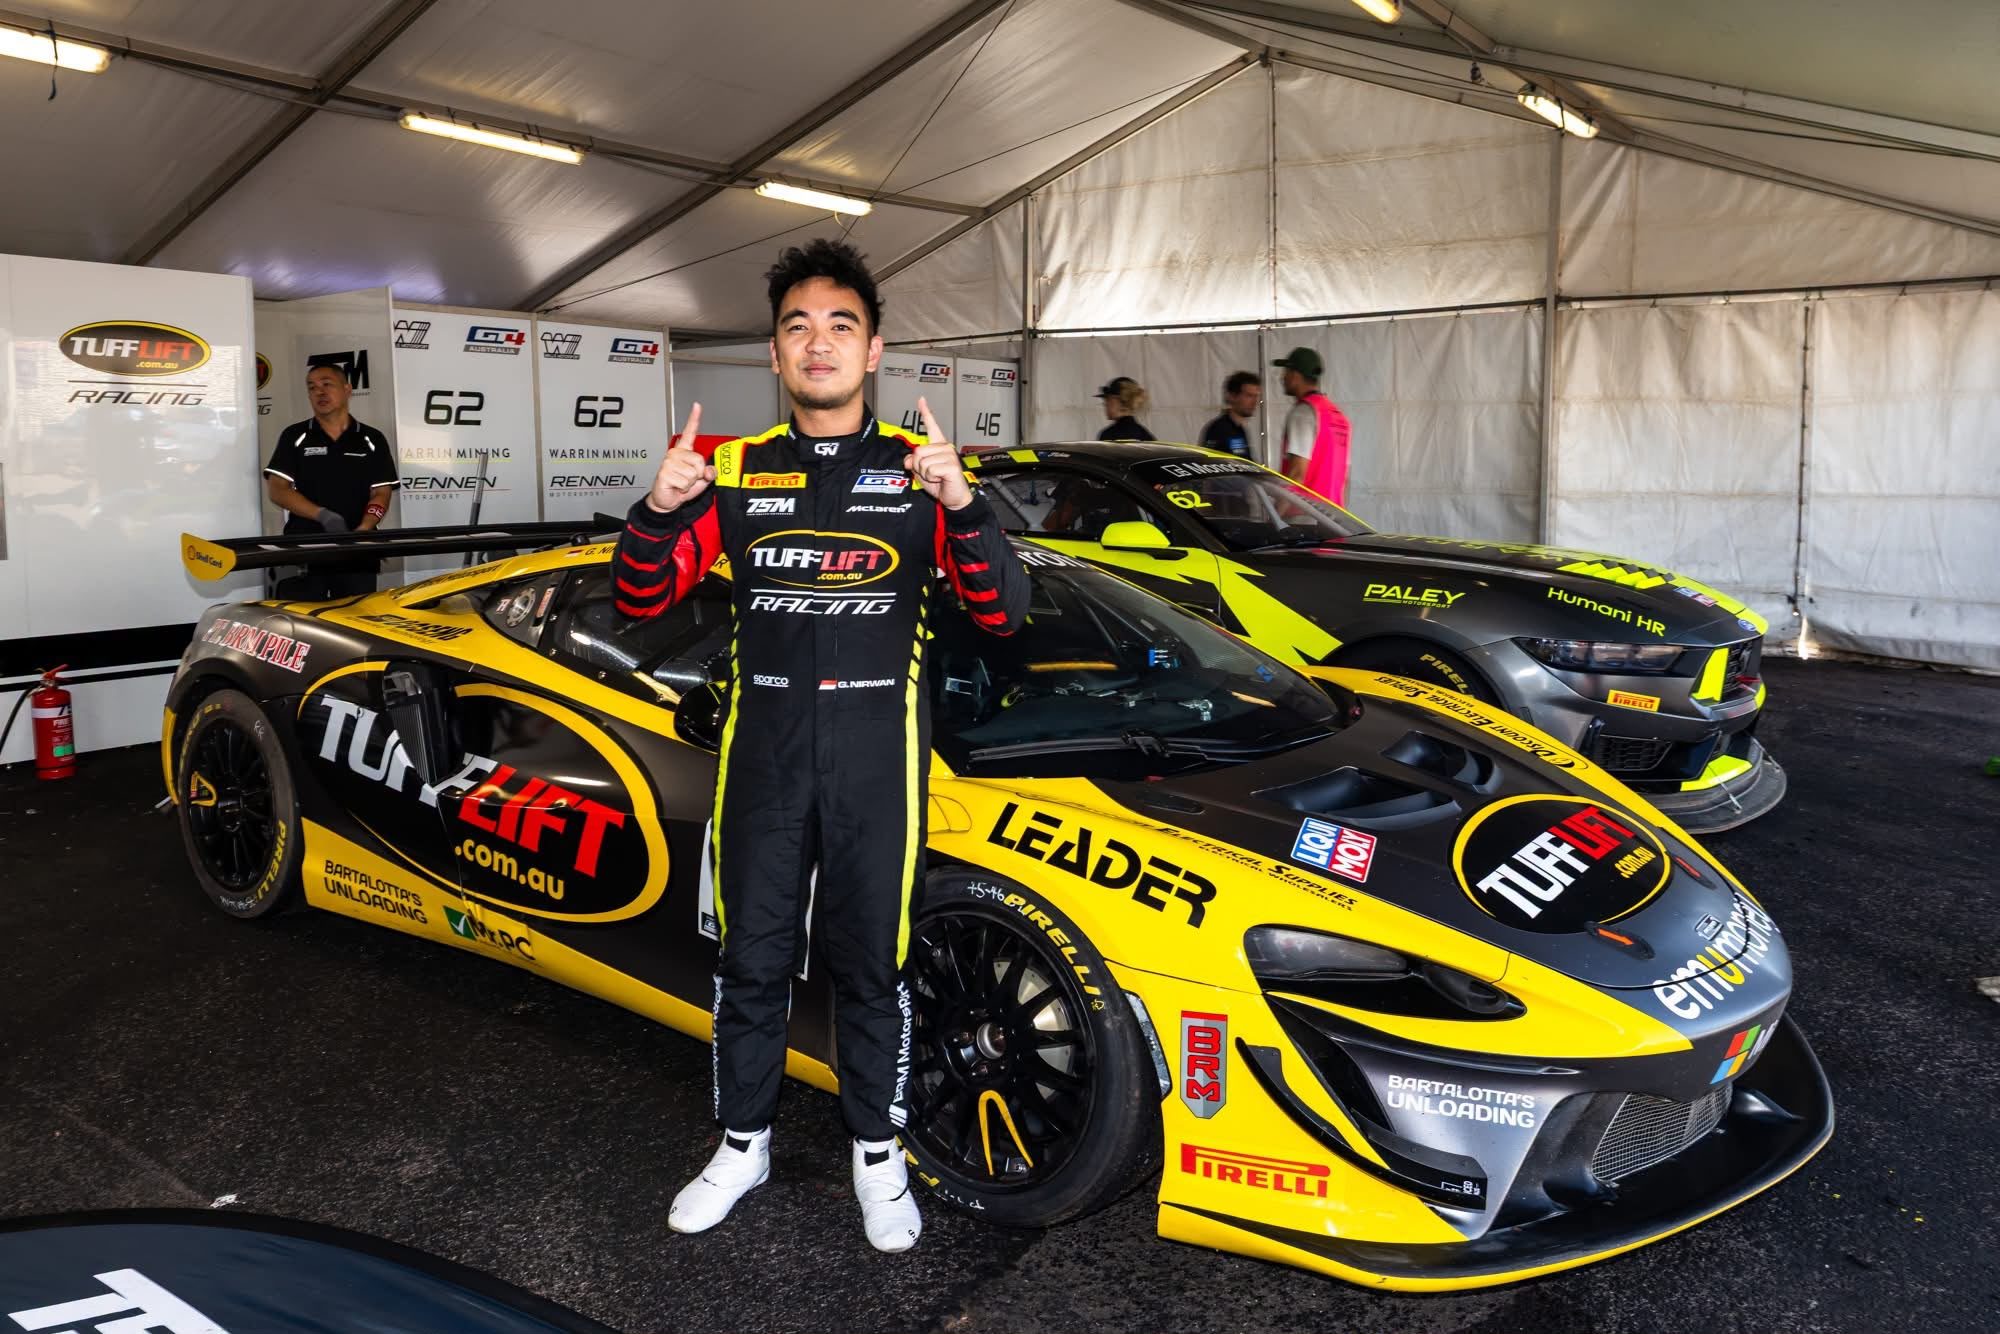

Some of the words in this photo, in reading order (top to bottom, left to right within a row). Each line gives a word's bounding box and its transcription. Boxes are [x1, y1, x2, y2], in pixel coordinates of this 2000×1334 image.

[69, 336, 197, 361] TUFFLIFT
[613, 355, 650, 364] AUSTRALIA
[136, 361, 179, 369] .com.au
[68, 390, 206, 406] RACING
[424, 390, 485, 425] 62
[574, 395, 624, 428] 62
[976, 412, 1001, 436] 46
[400, 448, 452, 459] ARRIN
[456, 448, 511, 459] MINING
[549, 448, 599, 459] WARRIN
[602, 449, 648, 459] MINING
[550, 475, 636, 488] RENNEN
[749, 474, 799, 487] PIRELLI
[747, 498, 796, 513] TSM
[846, 504, 911, 513] McLaren
[1166, 490, 1212, 509] 62
[195, 551, 209, 563] Shell
[208, 556, 223, 568] Card
[751, 547, 886, 571] TUFFLIFT
[817, 572, 863, 581] .com.au
[750, 596, 896, 615] RACING
[1364, 584, 1466, 604] PALEY
[1402, 600, 1451, 608] MOTORSPORT
[1548, 587, 1632, 623] Humani
[1636, 615, 1666, 637] HR
[256, 632, 311, 673] PILE
[753, 674, 790, 687] sparco
[838, 679, 896, 689] G.NIRWAN
[1613, 692, 1655, 709] PIRELLI
[1296, 821, 1338, 866] LIQUI
[1331, 829, 1372, 879] MOLY
[257, 819, 287, 901] PIRELLI
[455, 838, 565, 900] .com.au
[986, 801, 1218, 929] LEADER
[1158, 827, 1264, 866] ELECTRICAL
[1268, 865, 1358, 906] SUPPLIES
[1476, 806, 1636, 920] TUFFLIFT
[1614, 846, 1656, 879] .com.au
[324, 859, 423, 907] BARTALOTTA'S
[324, 877, 428, 924] UNLOADING
[1003, 893, 1101, 996] PIRELLI
[1186, 1025, 1221, 1102] BRM
[1388, 1074, 1535, 1109] BARTALOTTA'S
[1387, 1091, 1535, 1128] UNLOADING
[1181, 1143, 1331, 1198] PIRELLI
